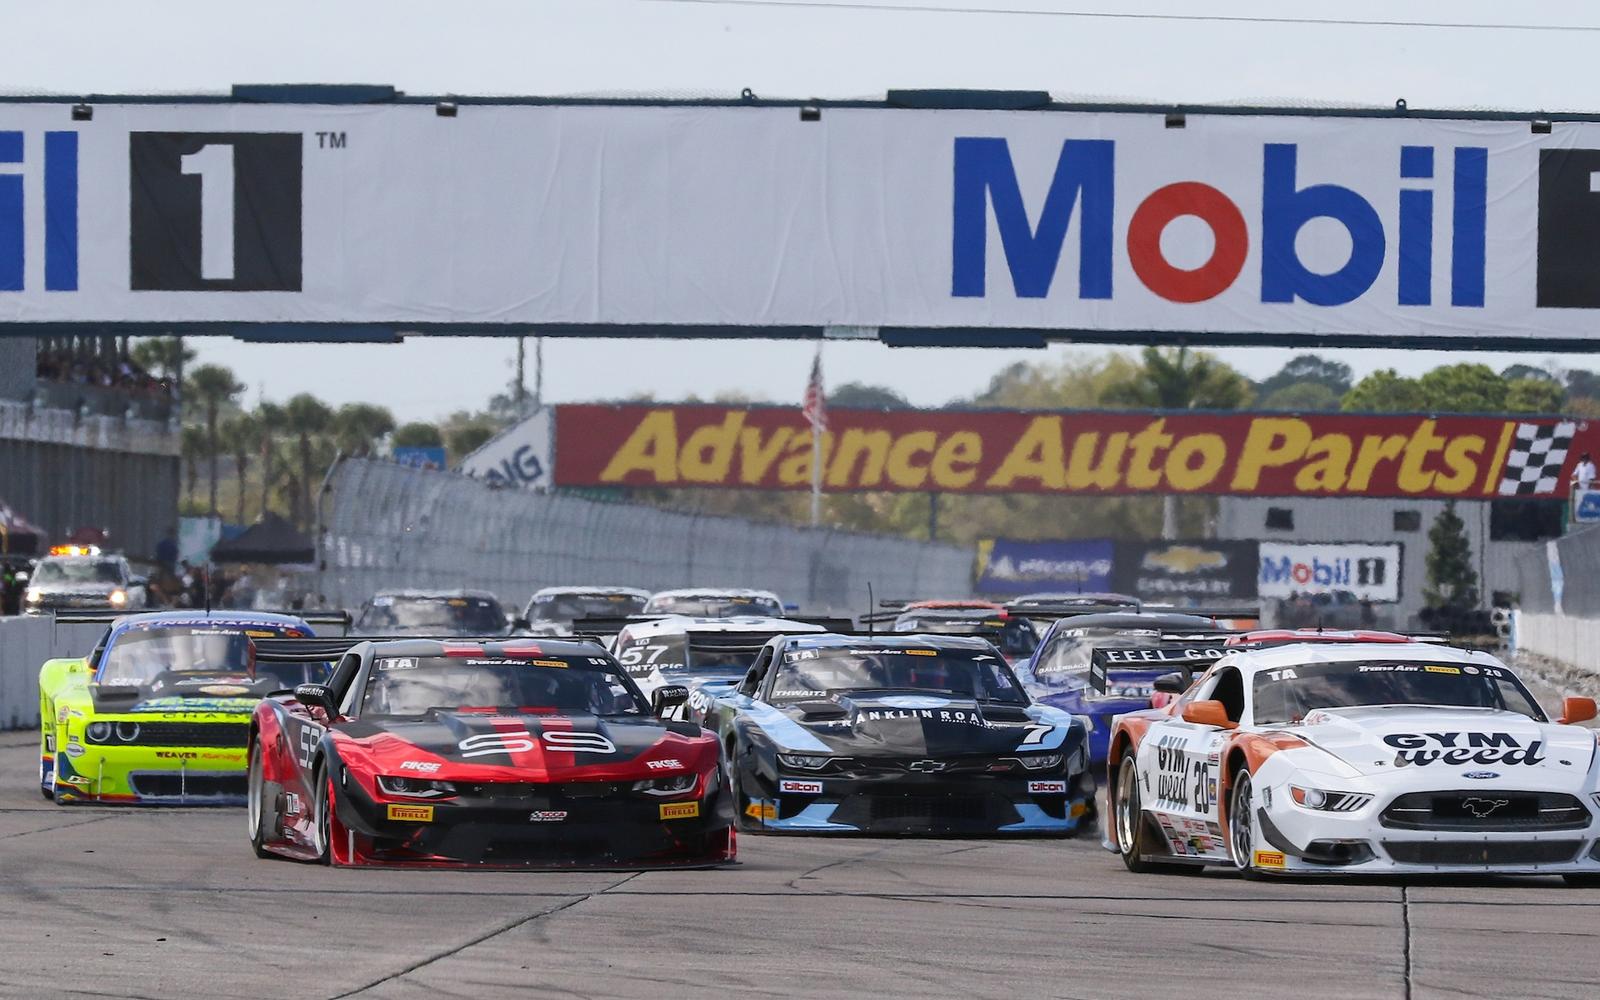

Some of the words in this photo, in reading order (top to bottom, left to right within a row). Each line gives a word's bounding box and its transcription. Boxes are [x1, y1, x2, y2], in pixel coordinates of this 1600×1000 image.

[181, 144, 235, 280] 1
[316, 133, 347, 149] TM
[951, 137, 1488, 306] Mobil
[600, 409, 983, 487] Advance
[988, 415, 1227, 490] Auto
[1231, 418, 1485, 493] Parts
[1260, 556, 1350, 586] Mobil
[387, 659, 414, 668] TA
[619, 646, 668, 665] 57
[1106, 650, 1173, 662] FEEL
[1267, 669, 1298, 681] TA
[1483, 668, 1503, 677] 20
[828, 709, 933, 728] FRANKLIN
[1022, 724, 1055, 744] 7
[1383, 733, 1521, 749] GYM
[156, 751, 197, 759] WEAVER
[1158, 735, 1188, 773] GYM
[1394, 741, 1546, 767] weed
[783, 782, 820, 792] tilton
[1030, 782, 1064, 791] tilton
[1194, 760, 1210, 815] 20
[391, 807, 429, 818] PIRELLI
[1258, 853, 1283, 865] PIRELLI
